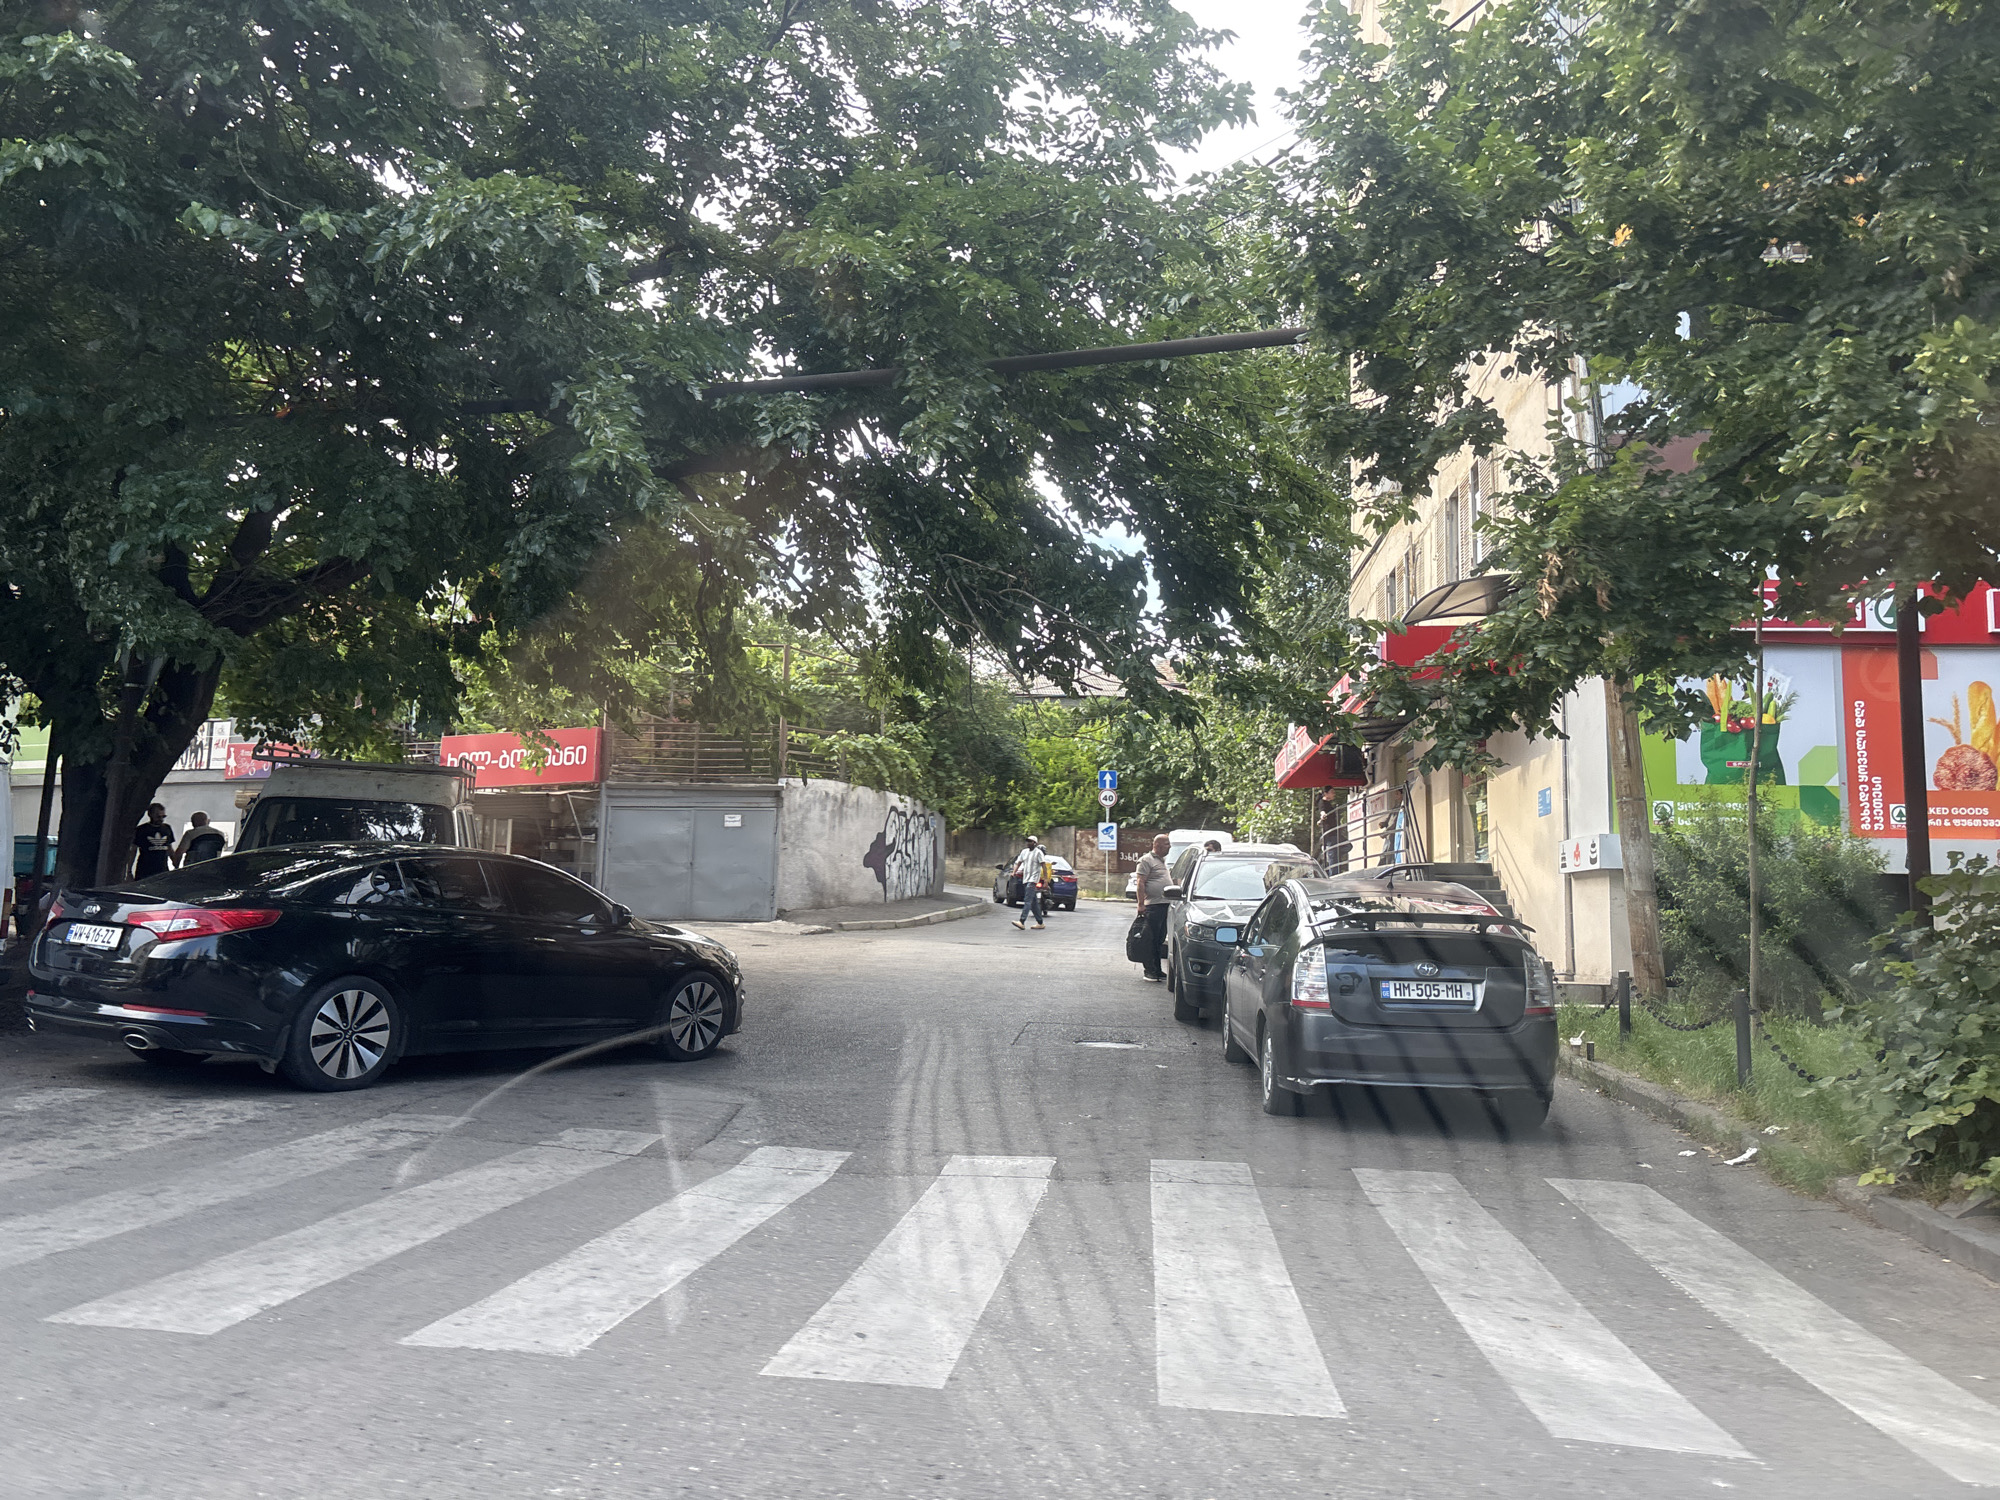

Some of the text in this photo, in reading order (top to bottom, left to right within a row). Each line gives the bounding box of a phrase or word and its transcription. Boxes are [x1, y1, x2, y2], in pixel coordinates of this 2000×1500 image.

[447, 745, 587, 770] ხილ-ბოანი
[1102, 794, 1114, 802] 40
[1928, 807, 1990, 815] KED GOODS
[1928, 818, 1942, 827] რი
[1393, 982, 1463, 999] HM-505-MH
